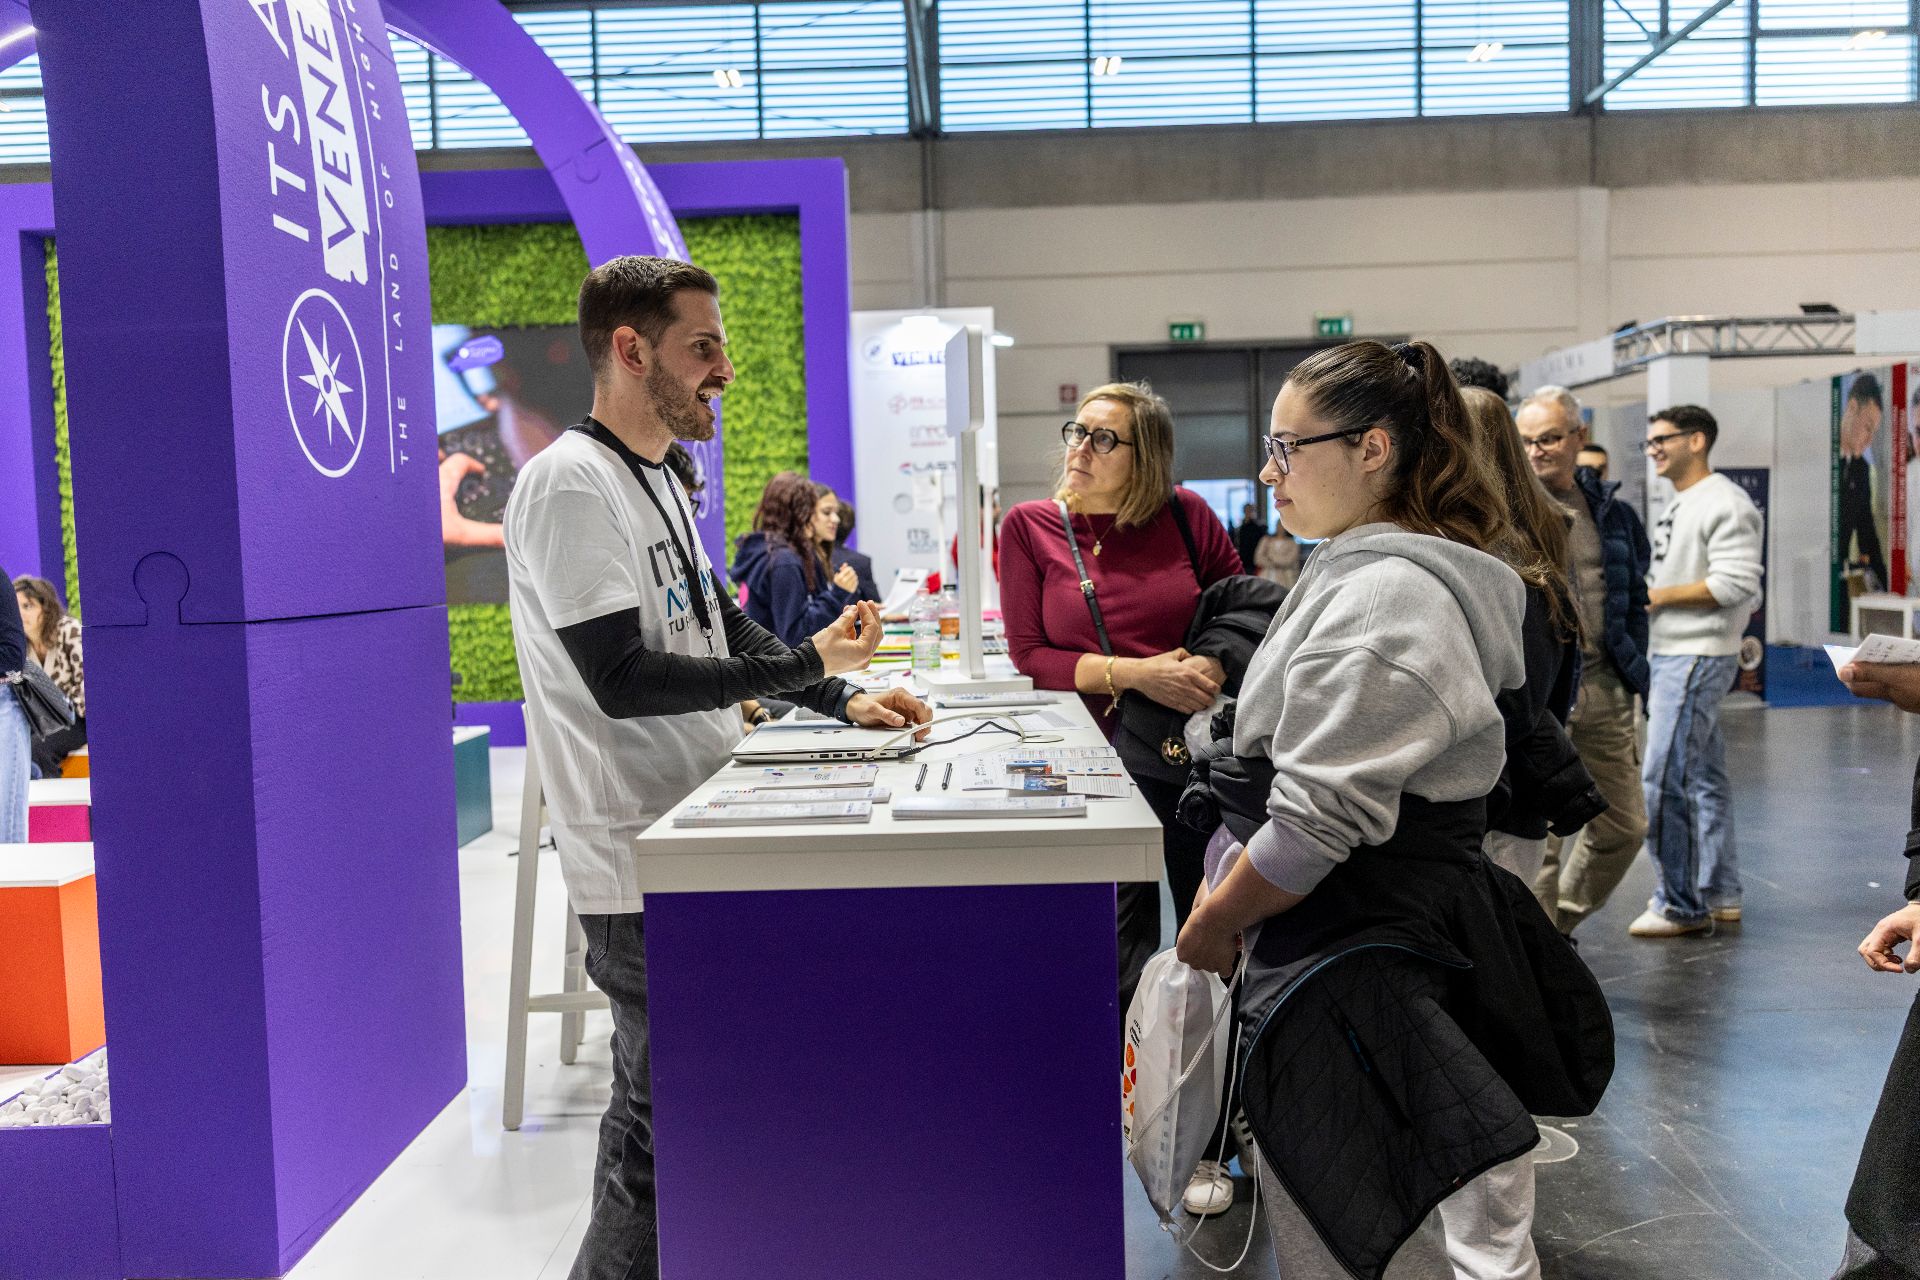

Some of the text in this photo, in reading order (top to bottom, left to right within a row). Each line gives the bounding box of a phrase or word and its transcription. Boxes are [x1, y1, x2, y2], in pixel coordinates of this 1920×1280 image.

[261, 83, 310, 242] ITS
[302, 10, 357, 250] VENE
[380, 163, 394, 208] OF
[389, 252, 404, 352] LAND
[397, 396, 409, 466] THE
